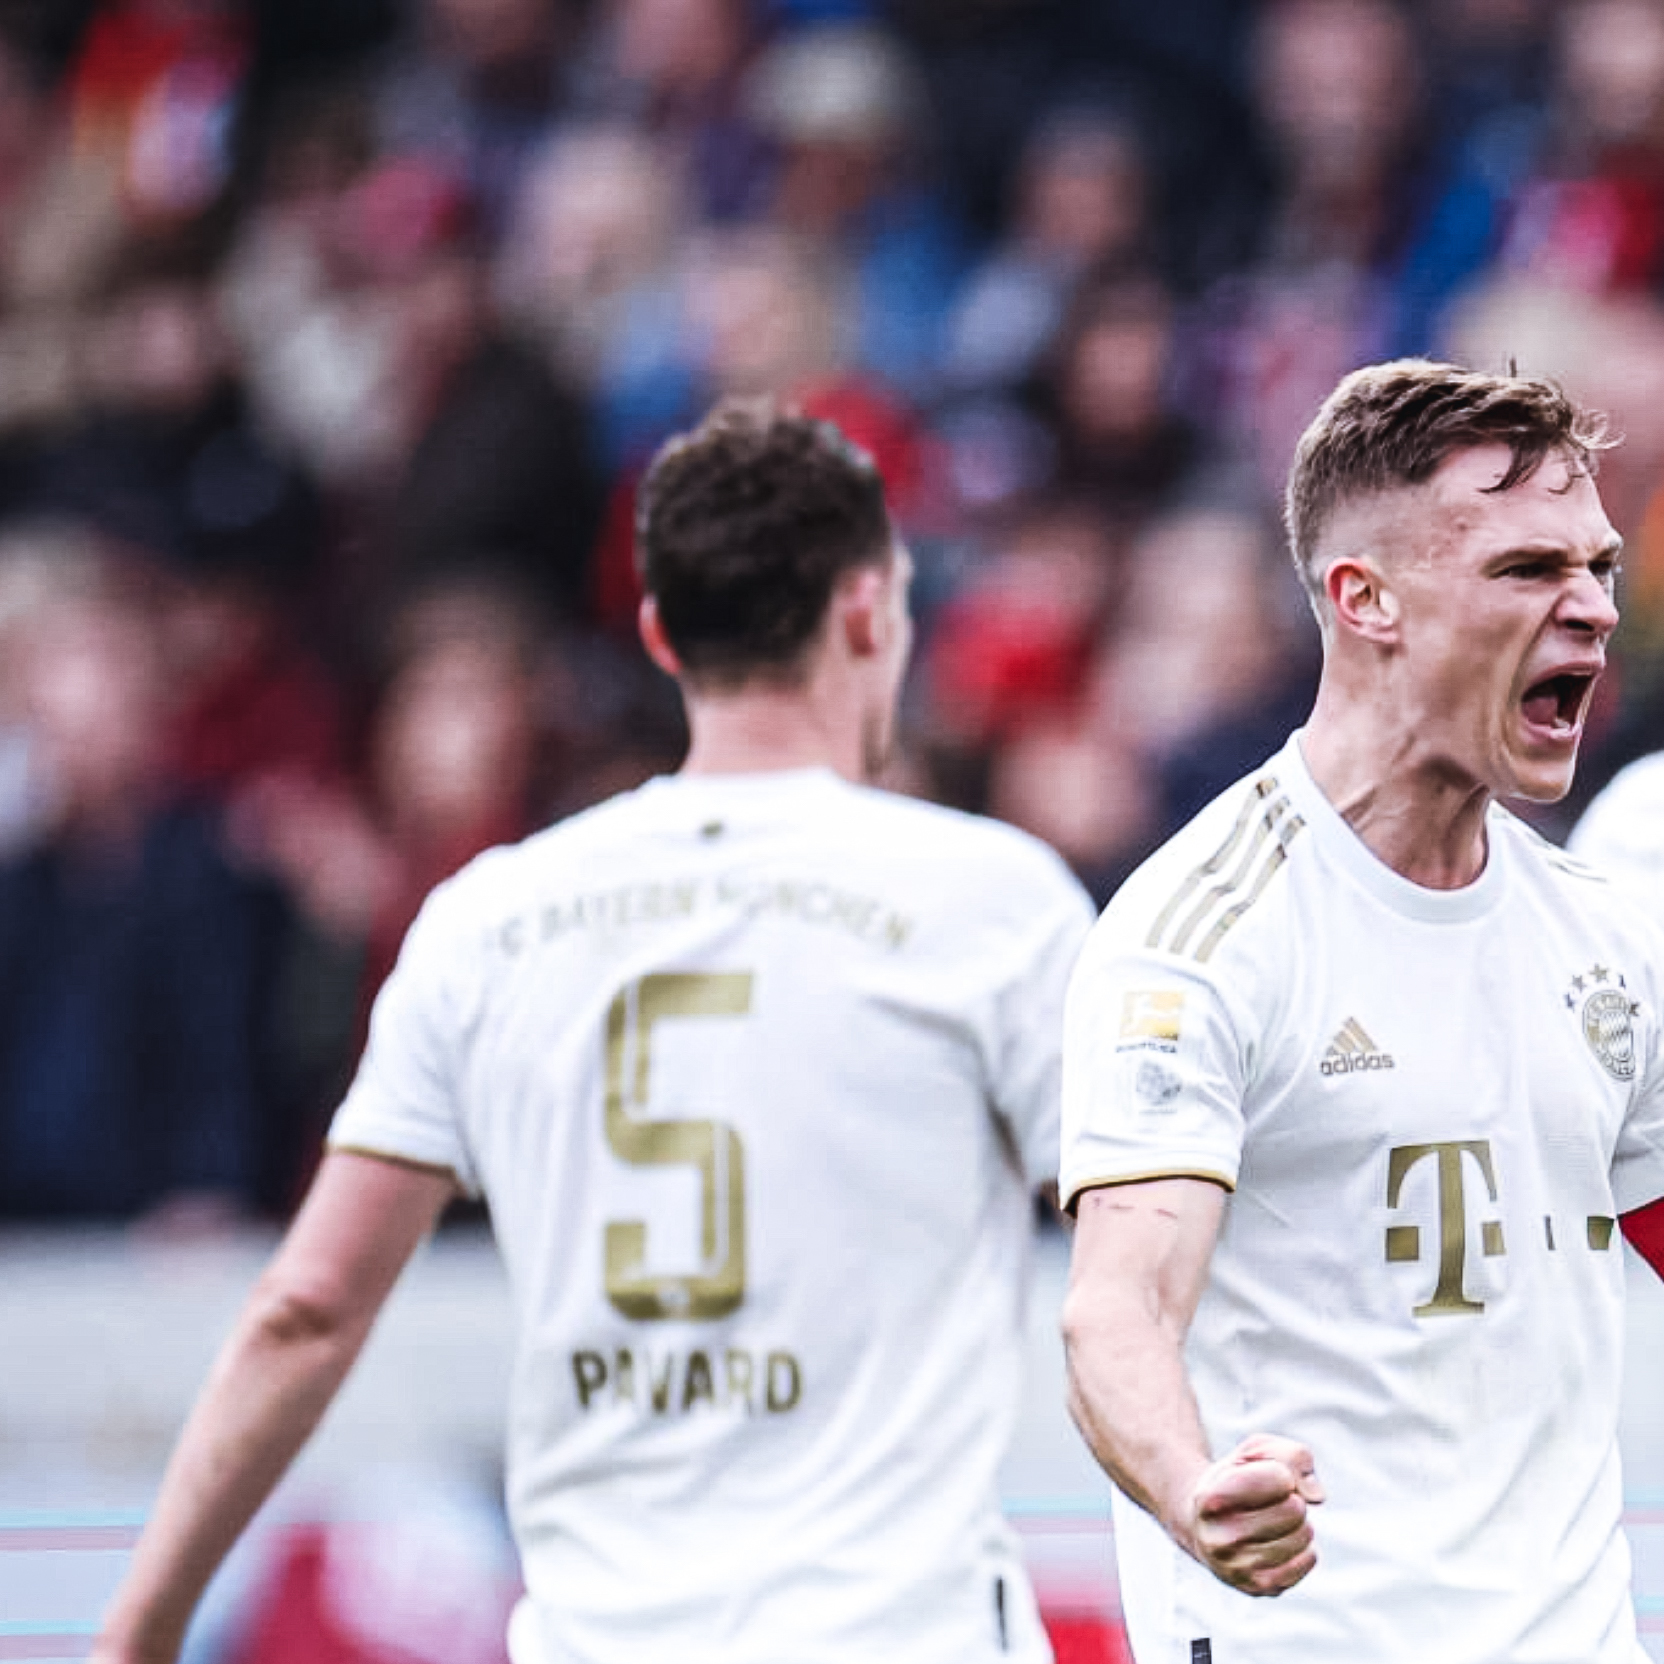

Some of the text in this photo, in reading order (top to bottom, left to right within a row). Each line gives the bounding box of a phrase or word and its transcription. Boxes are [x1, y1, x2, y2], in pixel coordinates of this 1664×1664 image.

[1320, 1052, 1394, 1075] adidas
[604, 972, 753, 1321] 5
[1386, 1140, 1500, 1316] T
[572, 1347, 803, 1415] PAVARD
